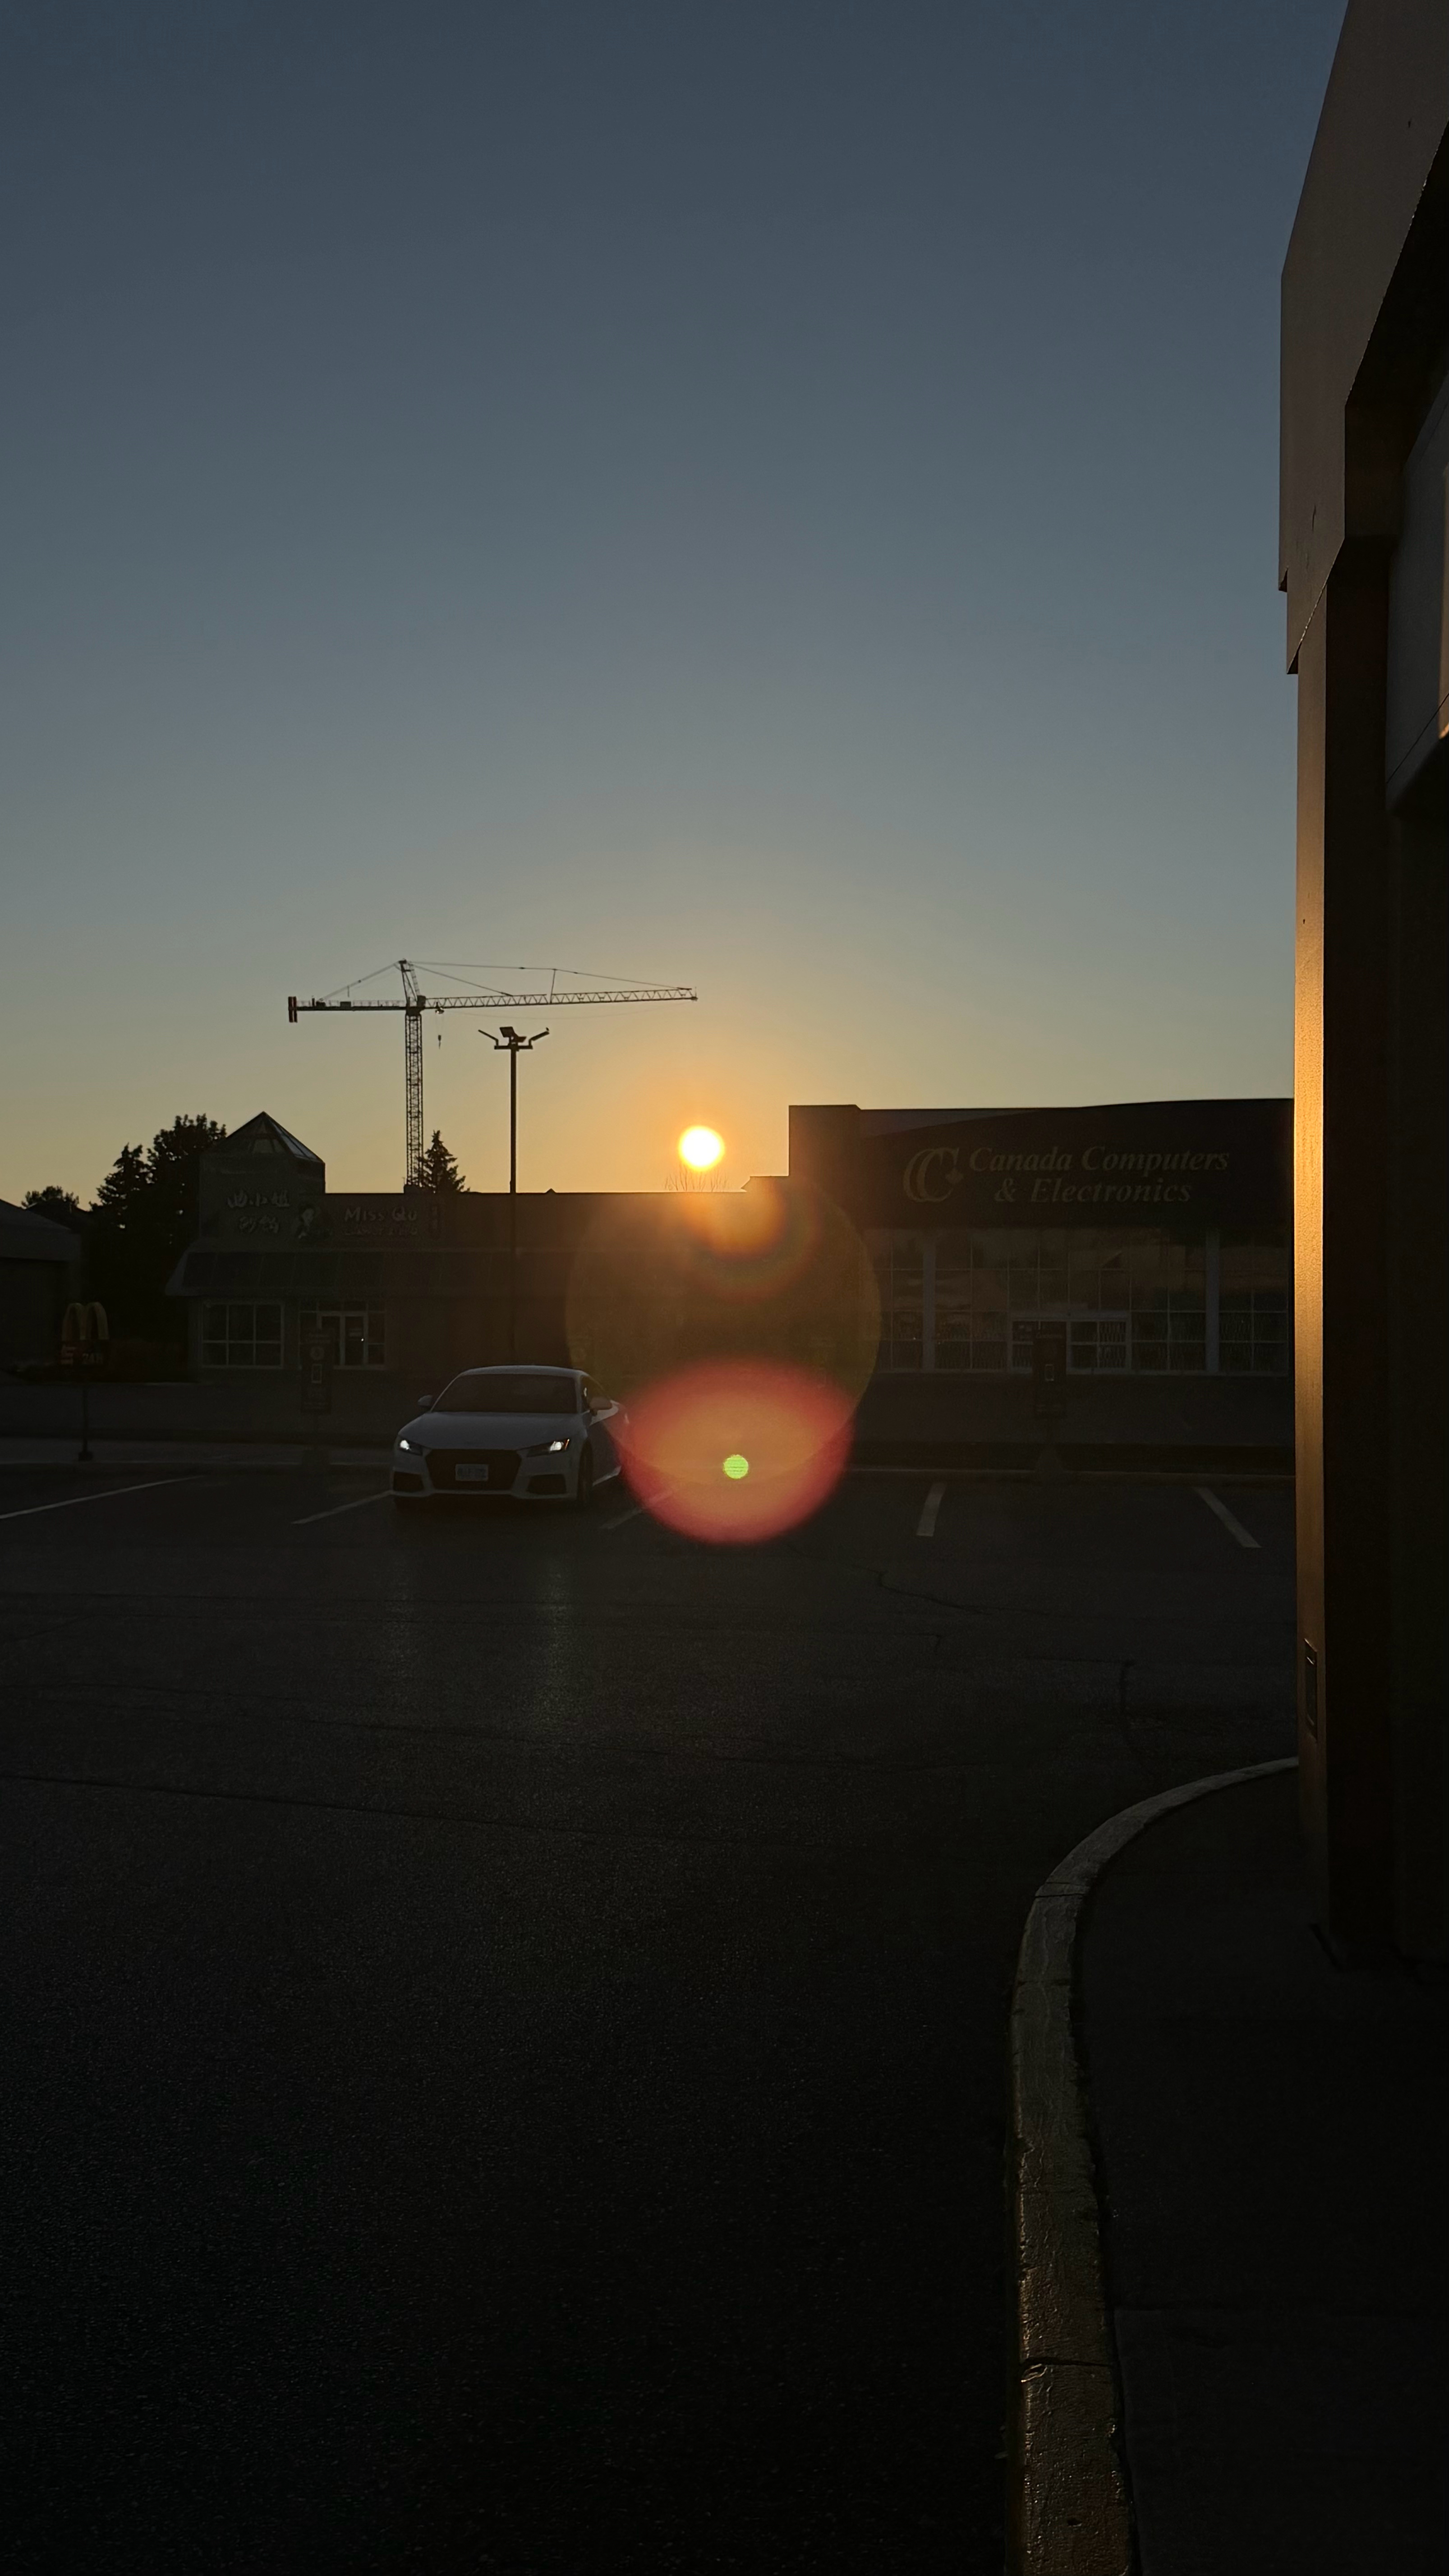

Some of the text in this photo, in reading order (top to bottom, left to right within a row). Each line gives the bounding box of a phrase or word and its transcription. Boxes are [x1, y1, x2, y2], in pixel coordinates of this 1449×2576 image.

[970, 1146, 1230, 1177] Canada Computers
[994, 1177, 1192, 1203] & Electronics
